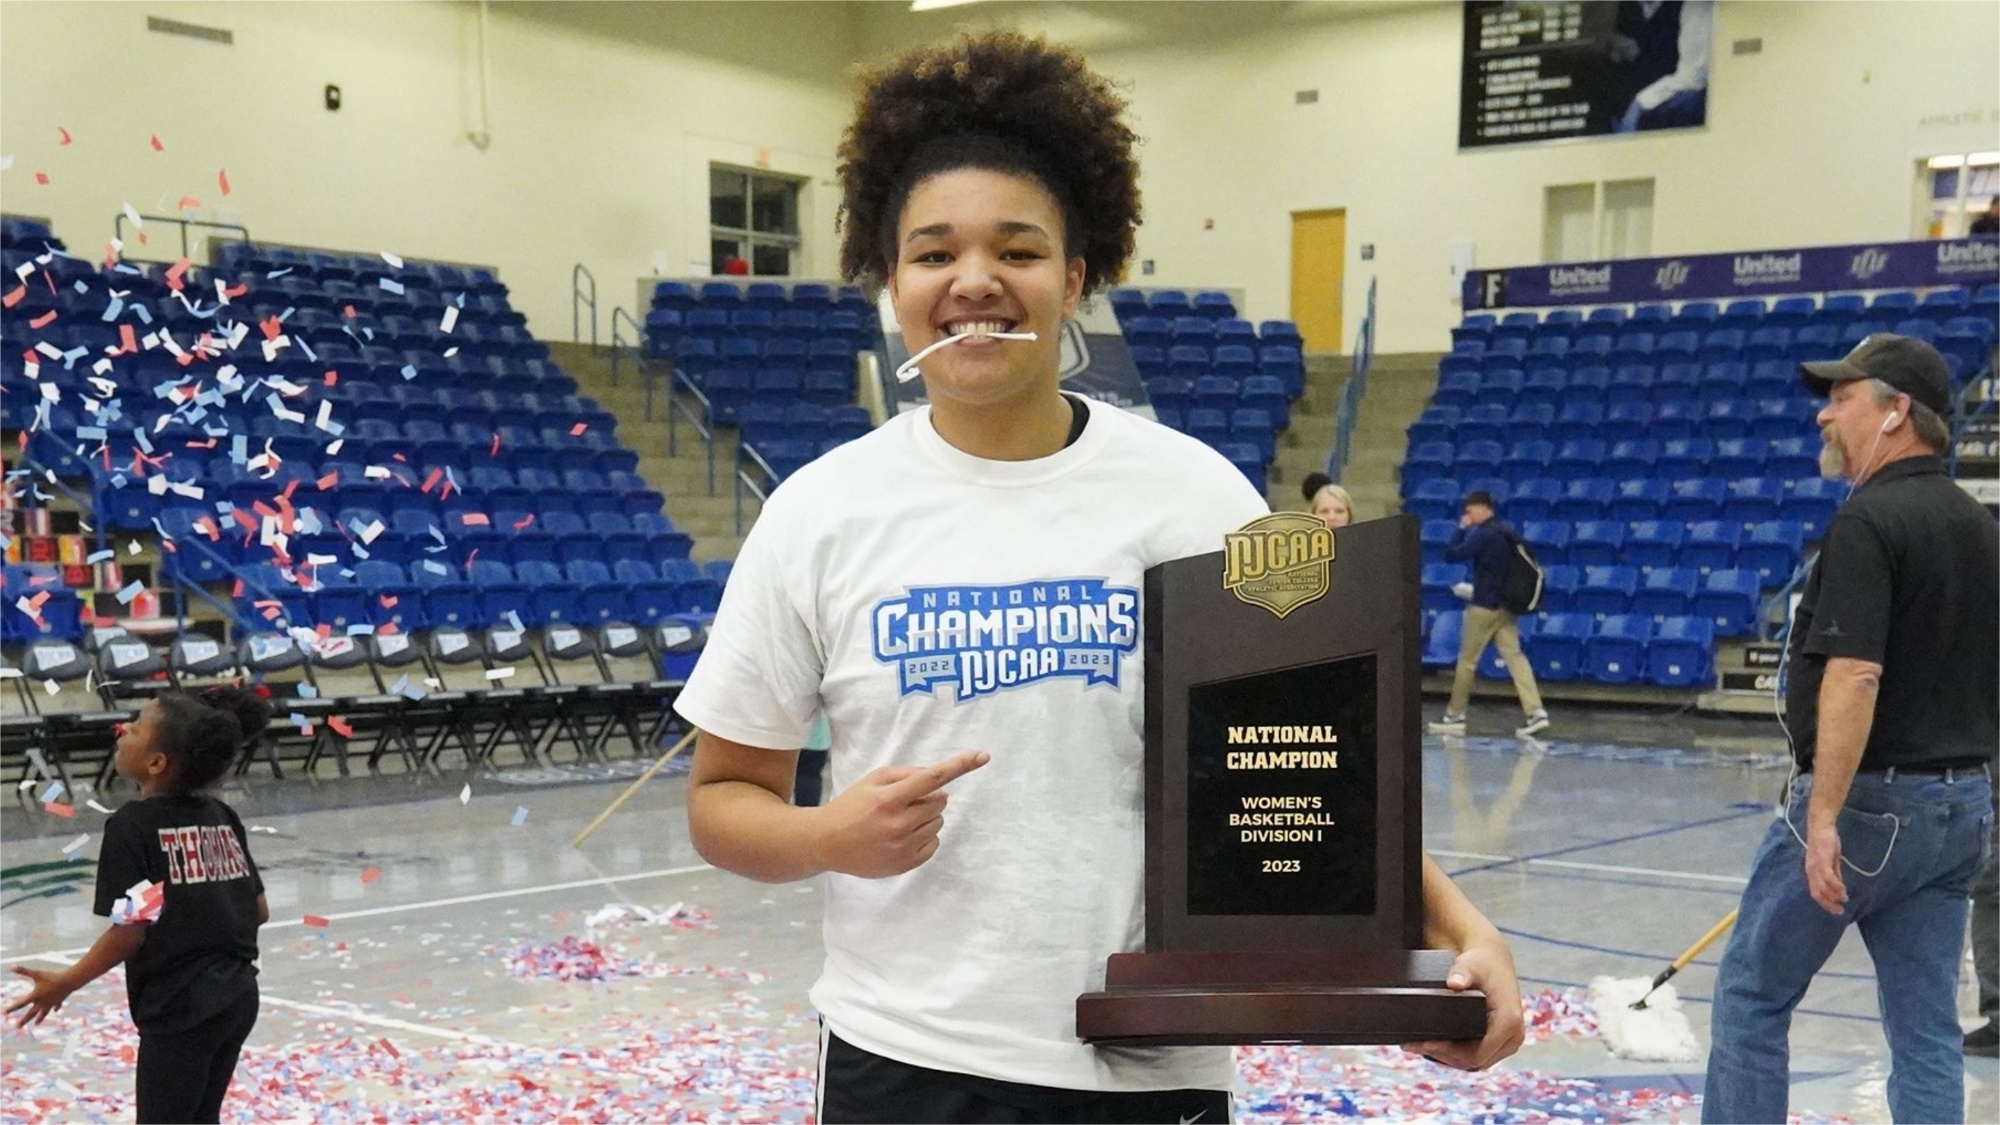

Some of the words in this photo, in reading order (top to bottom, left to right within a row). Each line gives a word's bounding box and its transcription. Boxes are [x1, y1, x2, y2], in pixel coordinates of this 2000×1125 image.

[1734, 252, 1801, 276] United
[1549, 264, 1611, 289] United
[1485, 273, 1502, 307] F
[1228, 528, 1330, 583] NJCAA
[923, 584, 1092, 608] NATIONAL
[877, 593, 1135, 657] CHAMPIONS
[909, 660, 950, 674] 2022
[960, 647, 1059, 697] NJCAA
[1069, 654, 1111, 665] 2023
[1227, 726, 1338, 744] NATIONAL
[1227, 751, 1338, 770] CHAMPION
[1241, 796, 1322, 809] WOMEN'S
[1229, 813, 1335, 826] BASKETBALL
[1241, 830, 1313, 842] DIVISION
[1317, 829, 1322, 842] I
[1262, 860, 1301, 873] 2023
